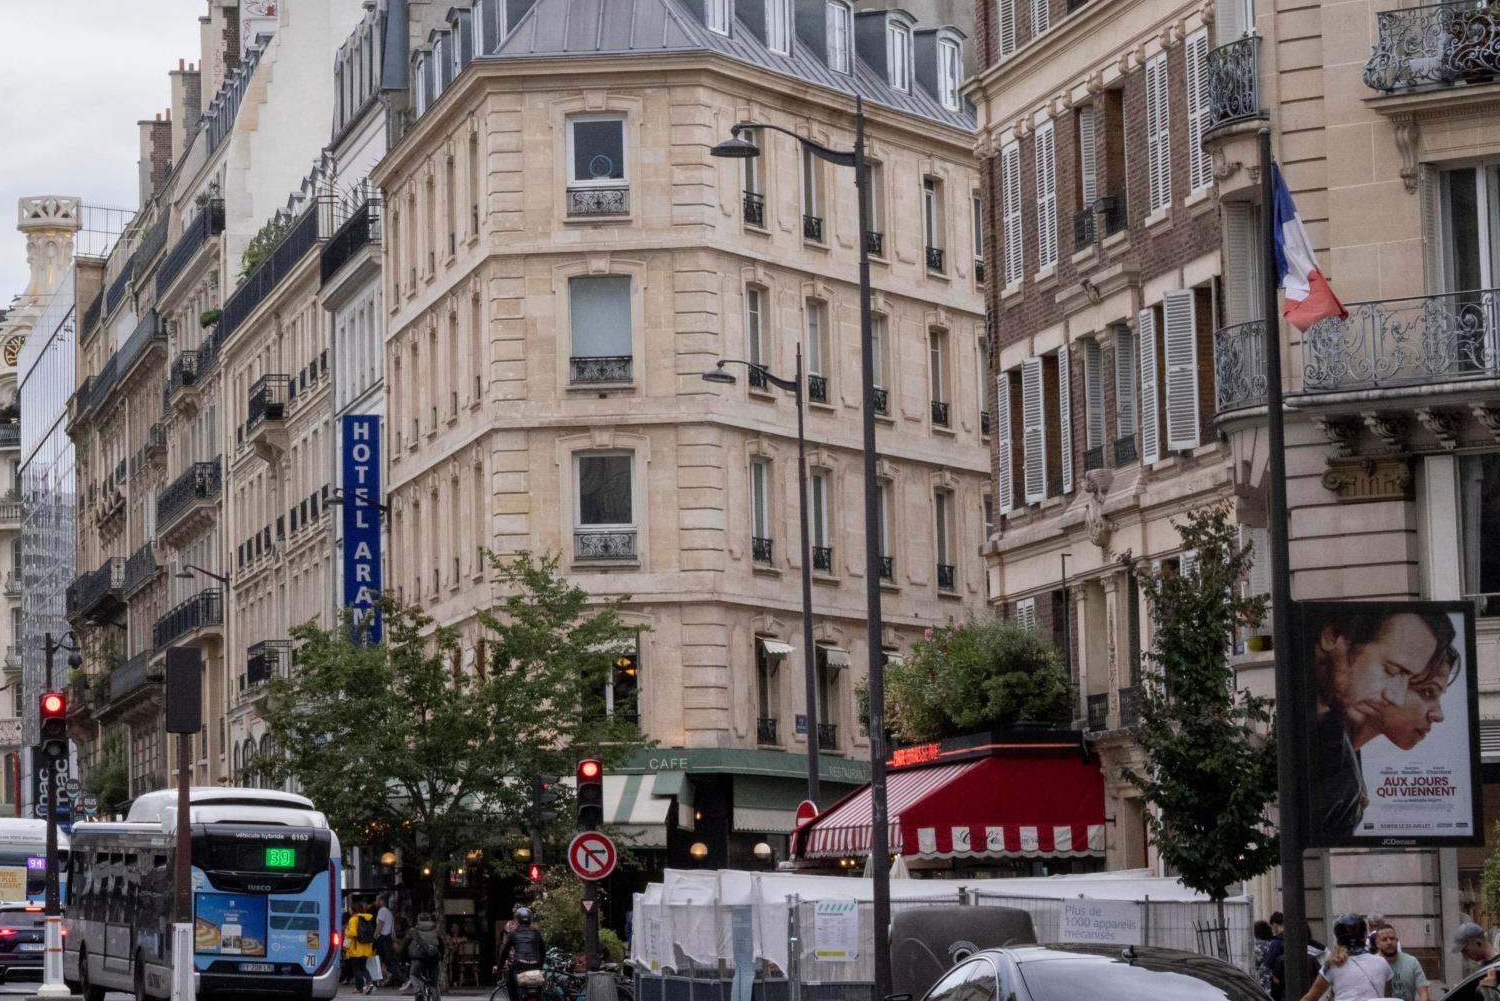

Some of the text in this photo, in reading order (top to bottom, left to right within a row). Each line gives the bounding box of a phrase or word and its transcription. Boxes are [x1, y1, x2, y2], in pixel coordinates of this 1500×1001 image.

[352, 422, 371, 528] HOTEL
[649, 758, 688, 770] CAFE
[1383, 776, 1449, 786] AUX JOURS
[1376, 786, 1457, 798] QUI VIENNENT
[1381, 838, 1417, 846] JCDecaux
[270, 849, 289, 865] 39
[30, 860, 42, 868] 94
[248, 884, 272, 892] IVECO
[1065, 905, 1102, 917] Plus de
[1065, 918, 1137, 930] 1000 appareils
[1064, 928, 1116, 941] mécanisés
[305, 955, 316, 967] 70
